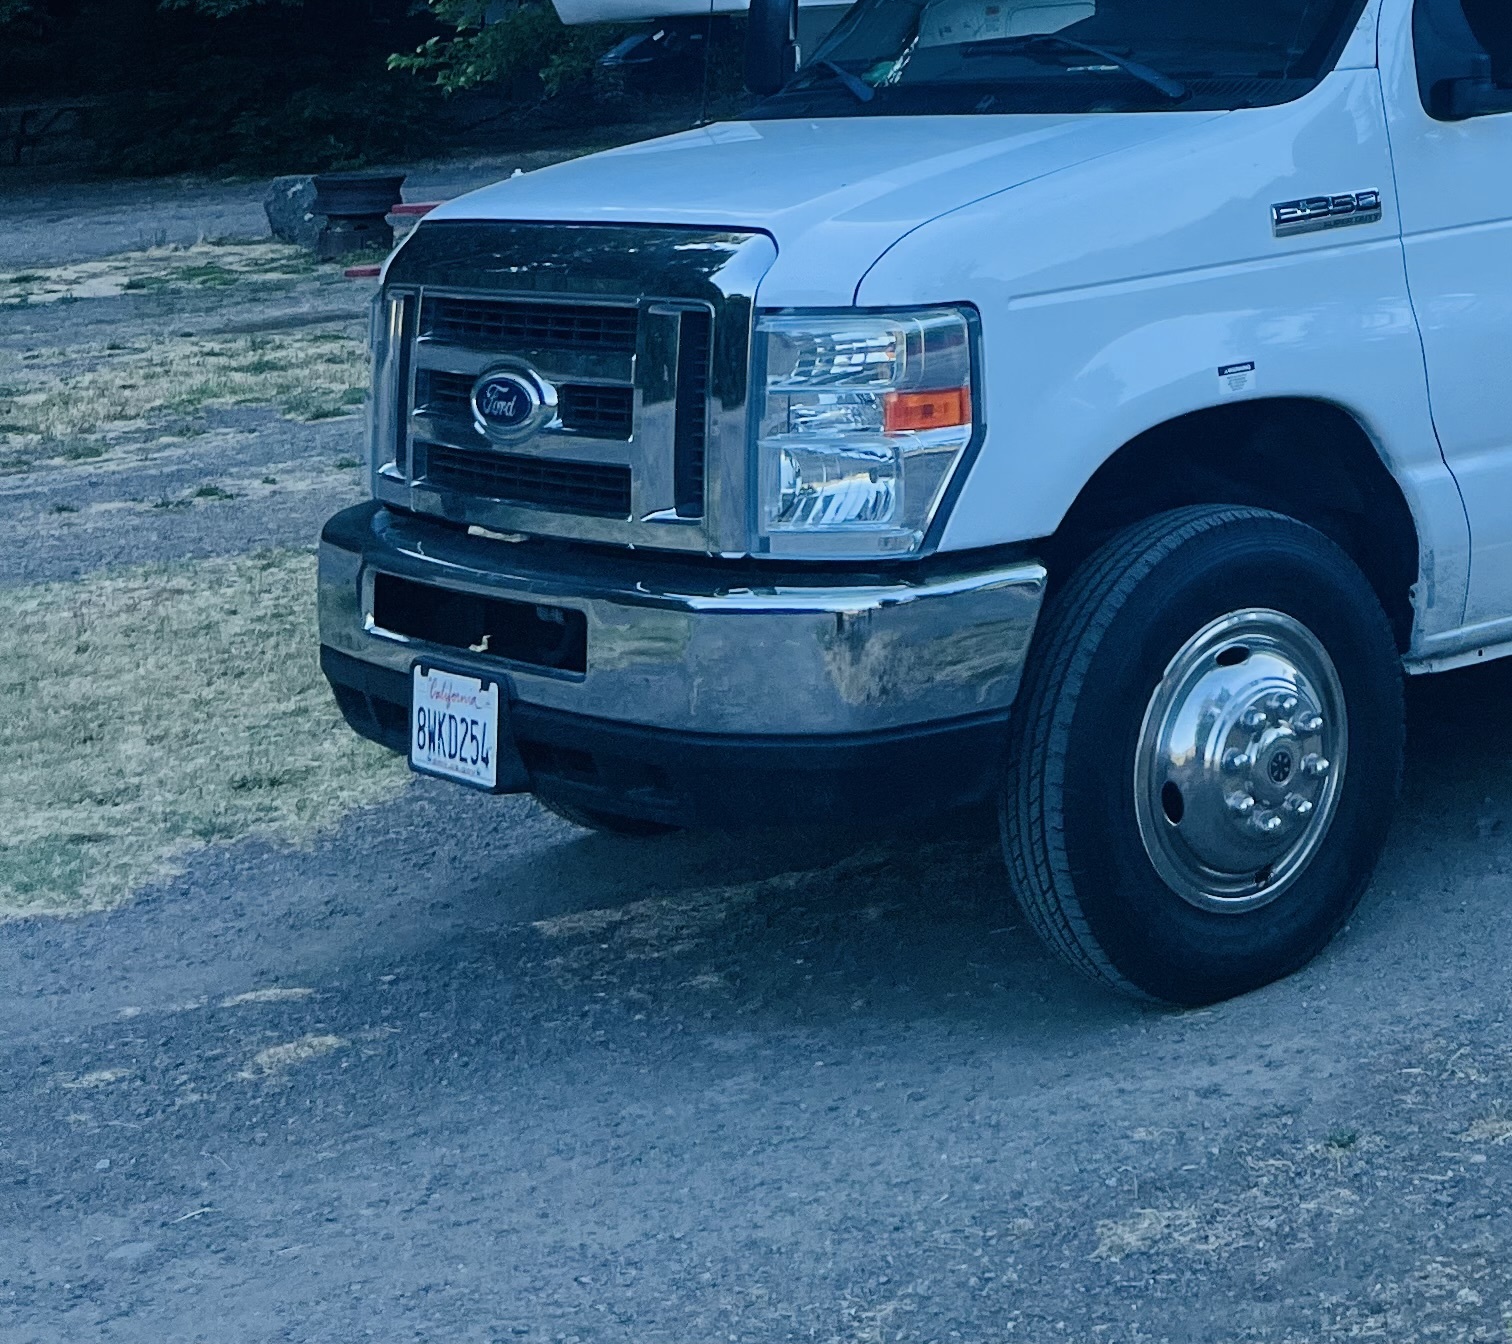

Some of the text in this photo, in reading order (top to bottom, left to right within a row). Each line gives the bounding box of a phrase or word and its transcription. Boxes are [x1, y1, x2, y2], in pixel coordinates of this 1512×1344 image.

[482, 383, 518, 417] Ford
[428, 677, 482, 710] California
[416, 706, 491, 769] 8WKD254
